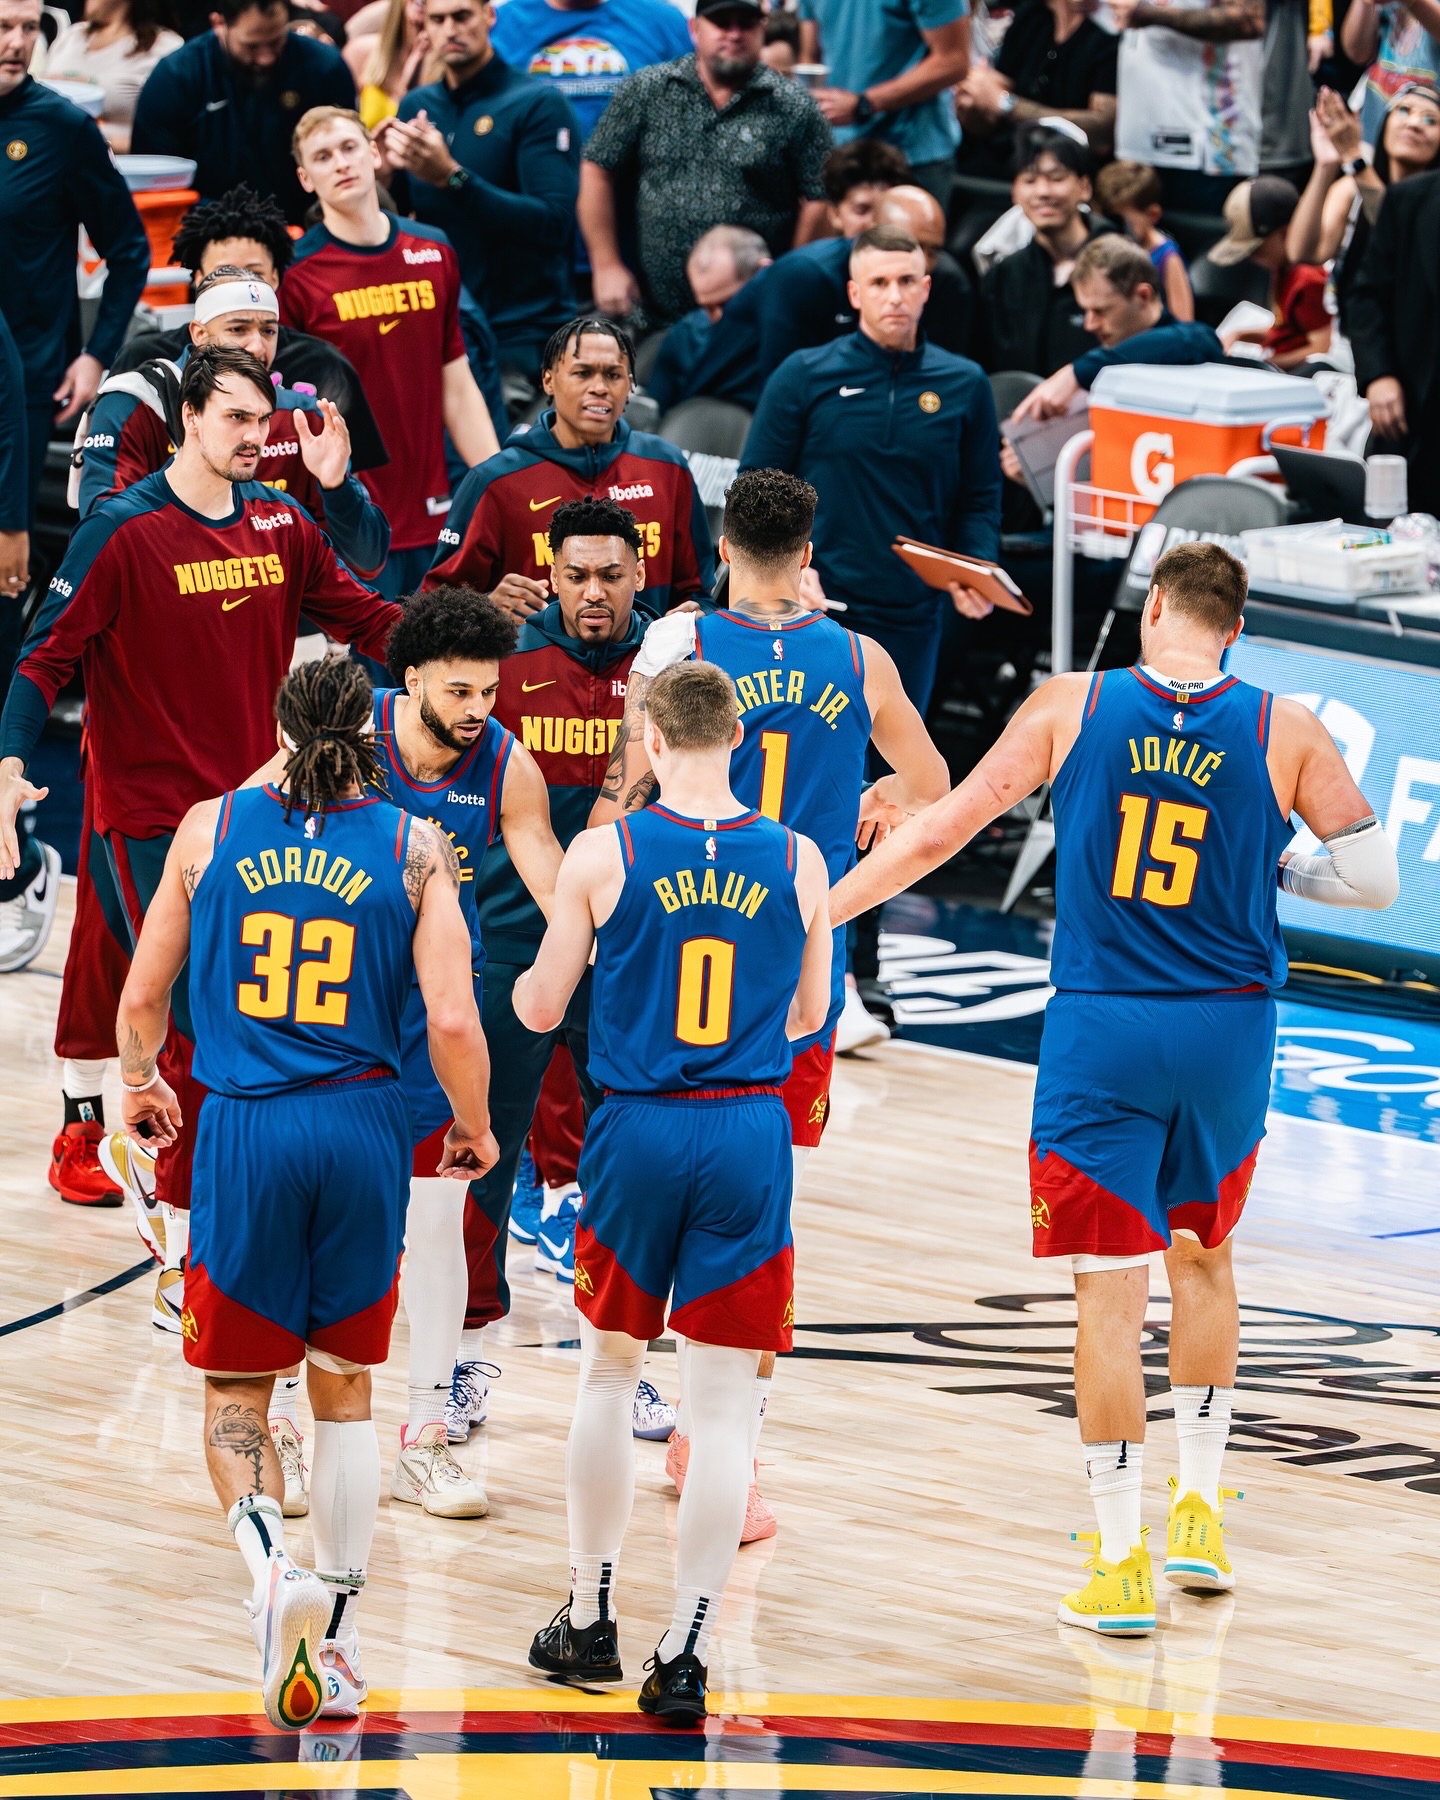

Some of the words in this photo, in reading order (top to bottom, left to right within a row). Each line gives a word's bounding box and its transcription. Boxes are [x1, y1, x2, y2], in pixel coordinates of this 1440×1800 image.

[332, 279, 436, 322] NUGGETS
[608, 485, 654, 501] ibotta
[250, 512, 294, 531] ibotta
[173, 553, 285, 595] NUGGETS
[809, 682, 851, 731] JR.
[1168, 680, 1187, 690] NIKE
[1187, 682, 1204, 690] PRO
[759, 730, 790, 823] 1
[1128, 736, 1227, 787] JOKIĆ
[447, 790, 486, 806] ibotta
[1110, 791, 1210, 908] 15
[235, 846, 373, 906] GORDON
[652, 868, 770, 920] BRAUN
[237, 910, 357, 1027] 32
[675, 935, 737, 1048] 0
